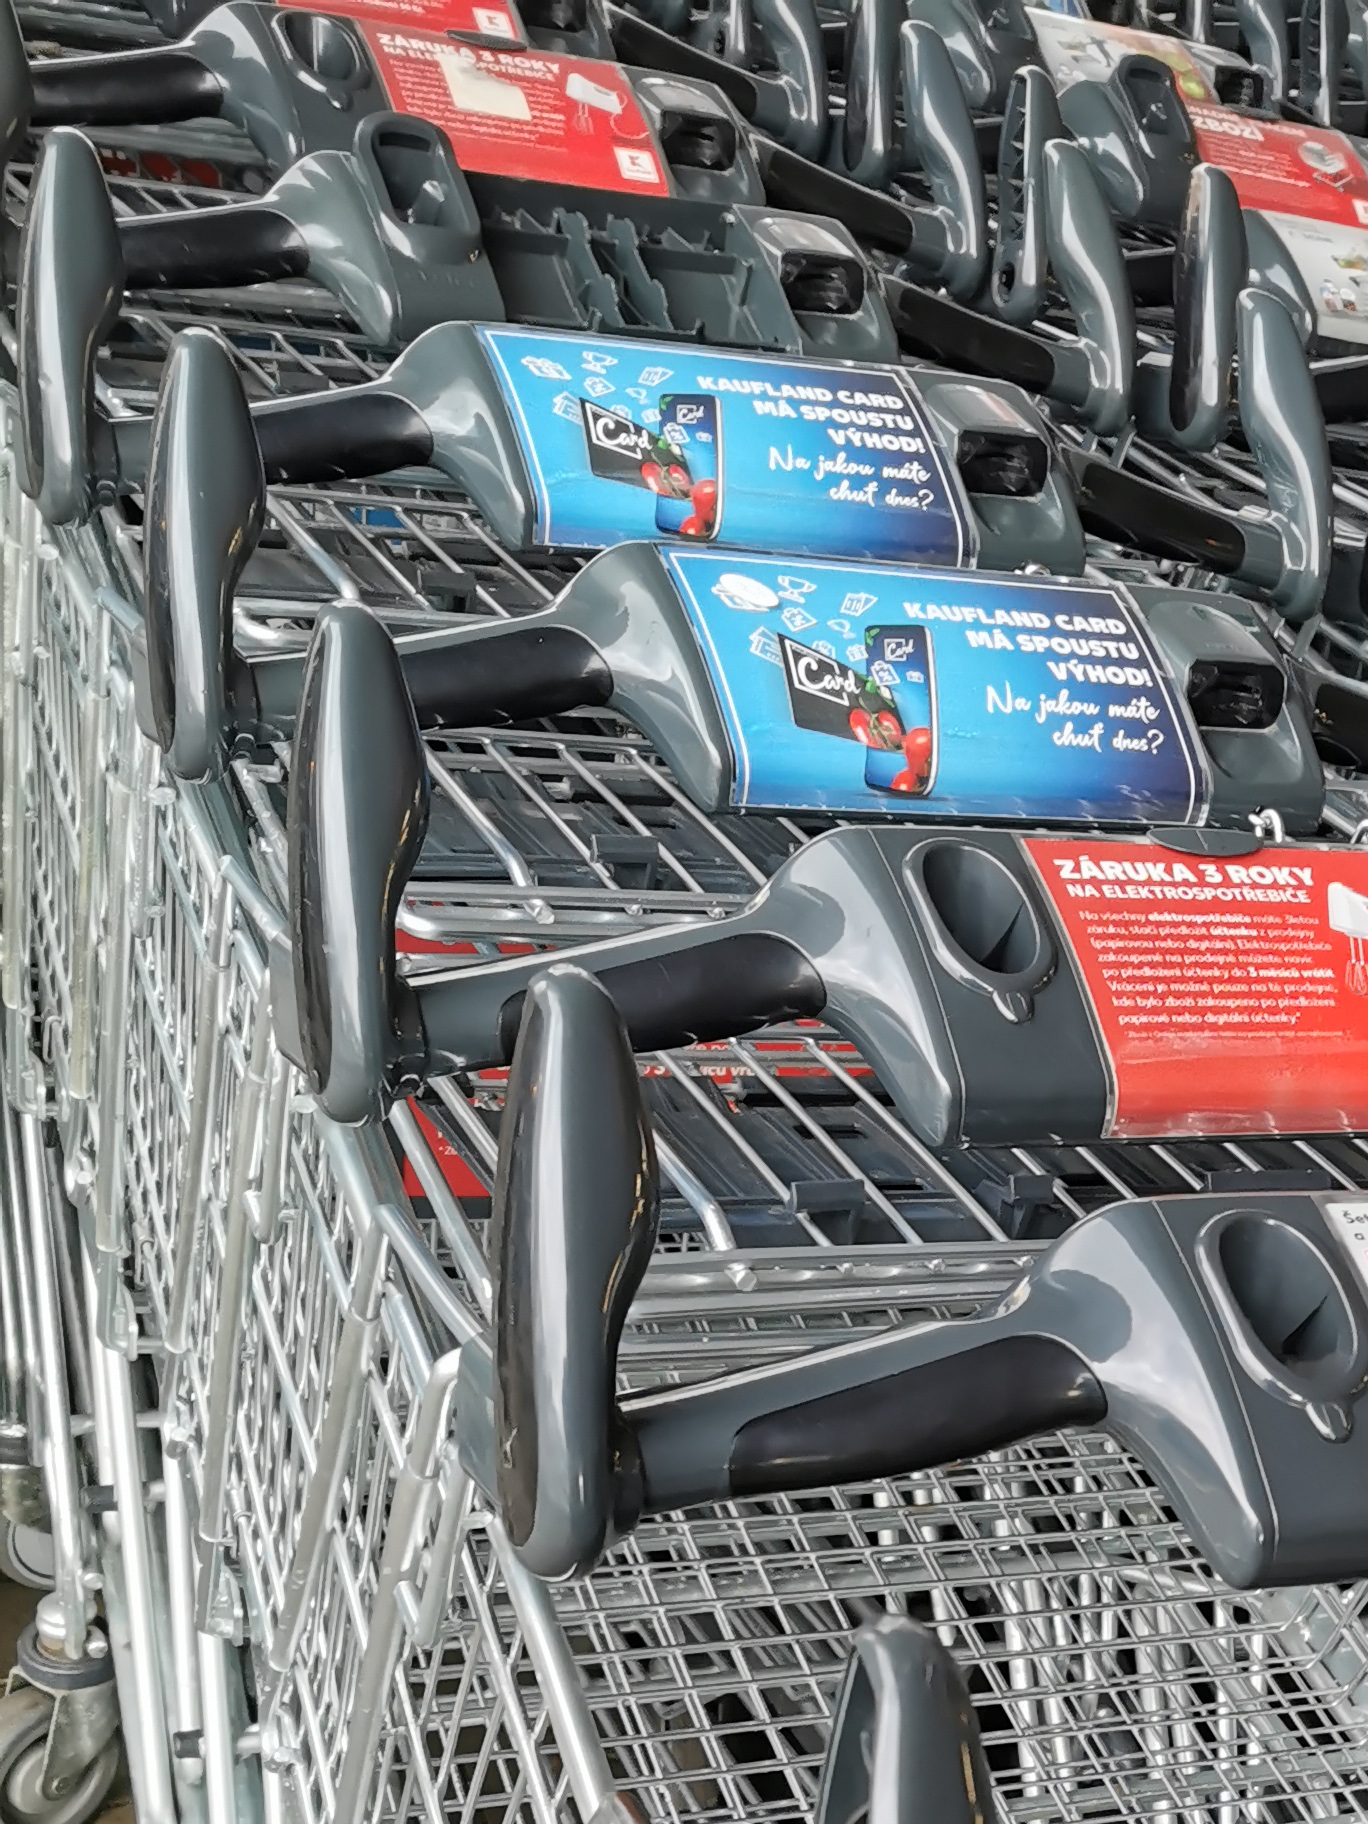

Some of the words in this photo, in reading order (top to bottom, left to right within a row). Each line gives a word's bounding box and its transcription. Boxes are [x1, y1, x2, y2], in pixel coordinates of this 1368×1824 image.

[376, 33, 477, 65] ZÁRUKA
[480, 49, 496, 65] 3
[500, 54, 560, 75] ROKY
[697, 375, 833, 402] KAUFLAND
[836, 388, 905, 411] CARD
[754, 397, 798, 420] MÁ
[803, 405, 915, 431] SPOUSTU
[595, 414, 653, 452] Card
[827, 426, 926, 455] VÝHOD!
[768, 445, 811, 473] Na
[815, 449, 875, 485] jakou
[881, 460, 932, 483] máte
[829, 481, 881, 508] chuť
[884, 488, 935, 513] dnes?
[903, 601, 1050, 633] KAUFLAND
[1055, 613, 1127, 635] CARD
[966, 628, 1014, 651] MÁ
[1019, 634, 1140, 661] SPOUSTU
[798, 659, 862, 696] Card
[1047, 658, 1154, 689] VÝHOD!
[987, 681, 1032, 714] Na
[1036, 689, 1101, 723] jakou
[1110, 697, 1160, 721] máte
[1053, 721, 1105, 751] chuť
[1112, 729, 1165, 755] dnes?
[1053, 856, 1198, 883] ZÁRUKA
[1198, 863, 1222, 884] 3
[1229, 864, 1313, 886] ROKY
[1066, 883, 1103, 898] NA
[1107, 882, 1311, 904] ELEKTROSPOTŘEBIČE
[1354, 1232, 1366, 1241] a
